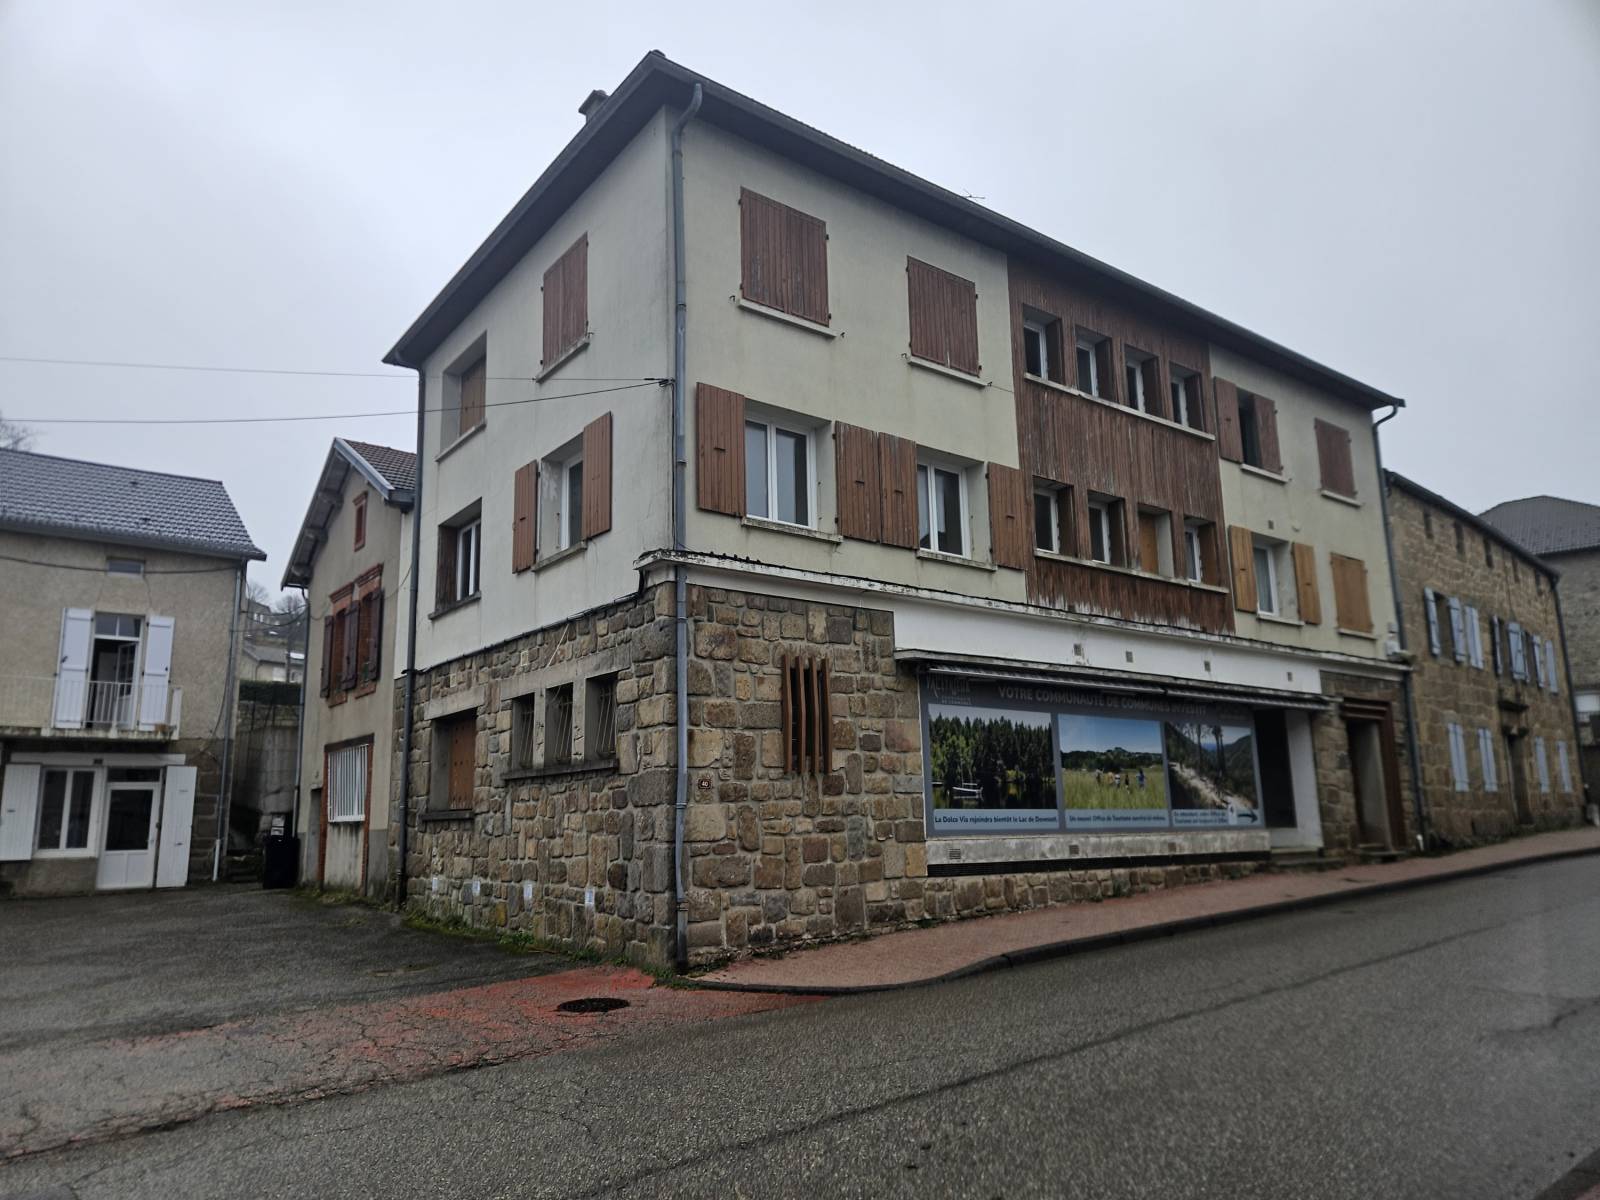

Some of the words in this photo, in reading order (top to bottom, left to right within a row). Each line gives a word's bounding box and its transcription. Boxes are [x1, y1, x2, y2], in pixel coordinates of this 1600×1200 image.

[998, 686, 1033, 701] VOTRE
[1106, 695, 1119, 708] DE
[1013, 815, 1018, 823] le
